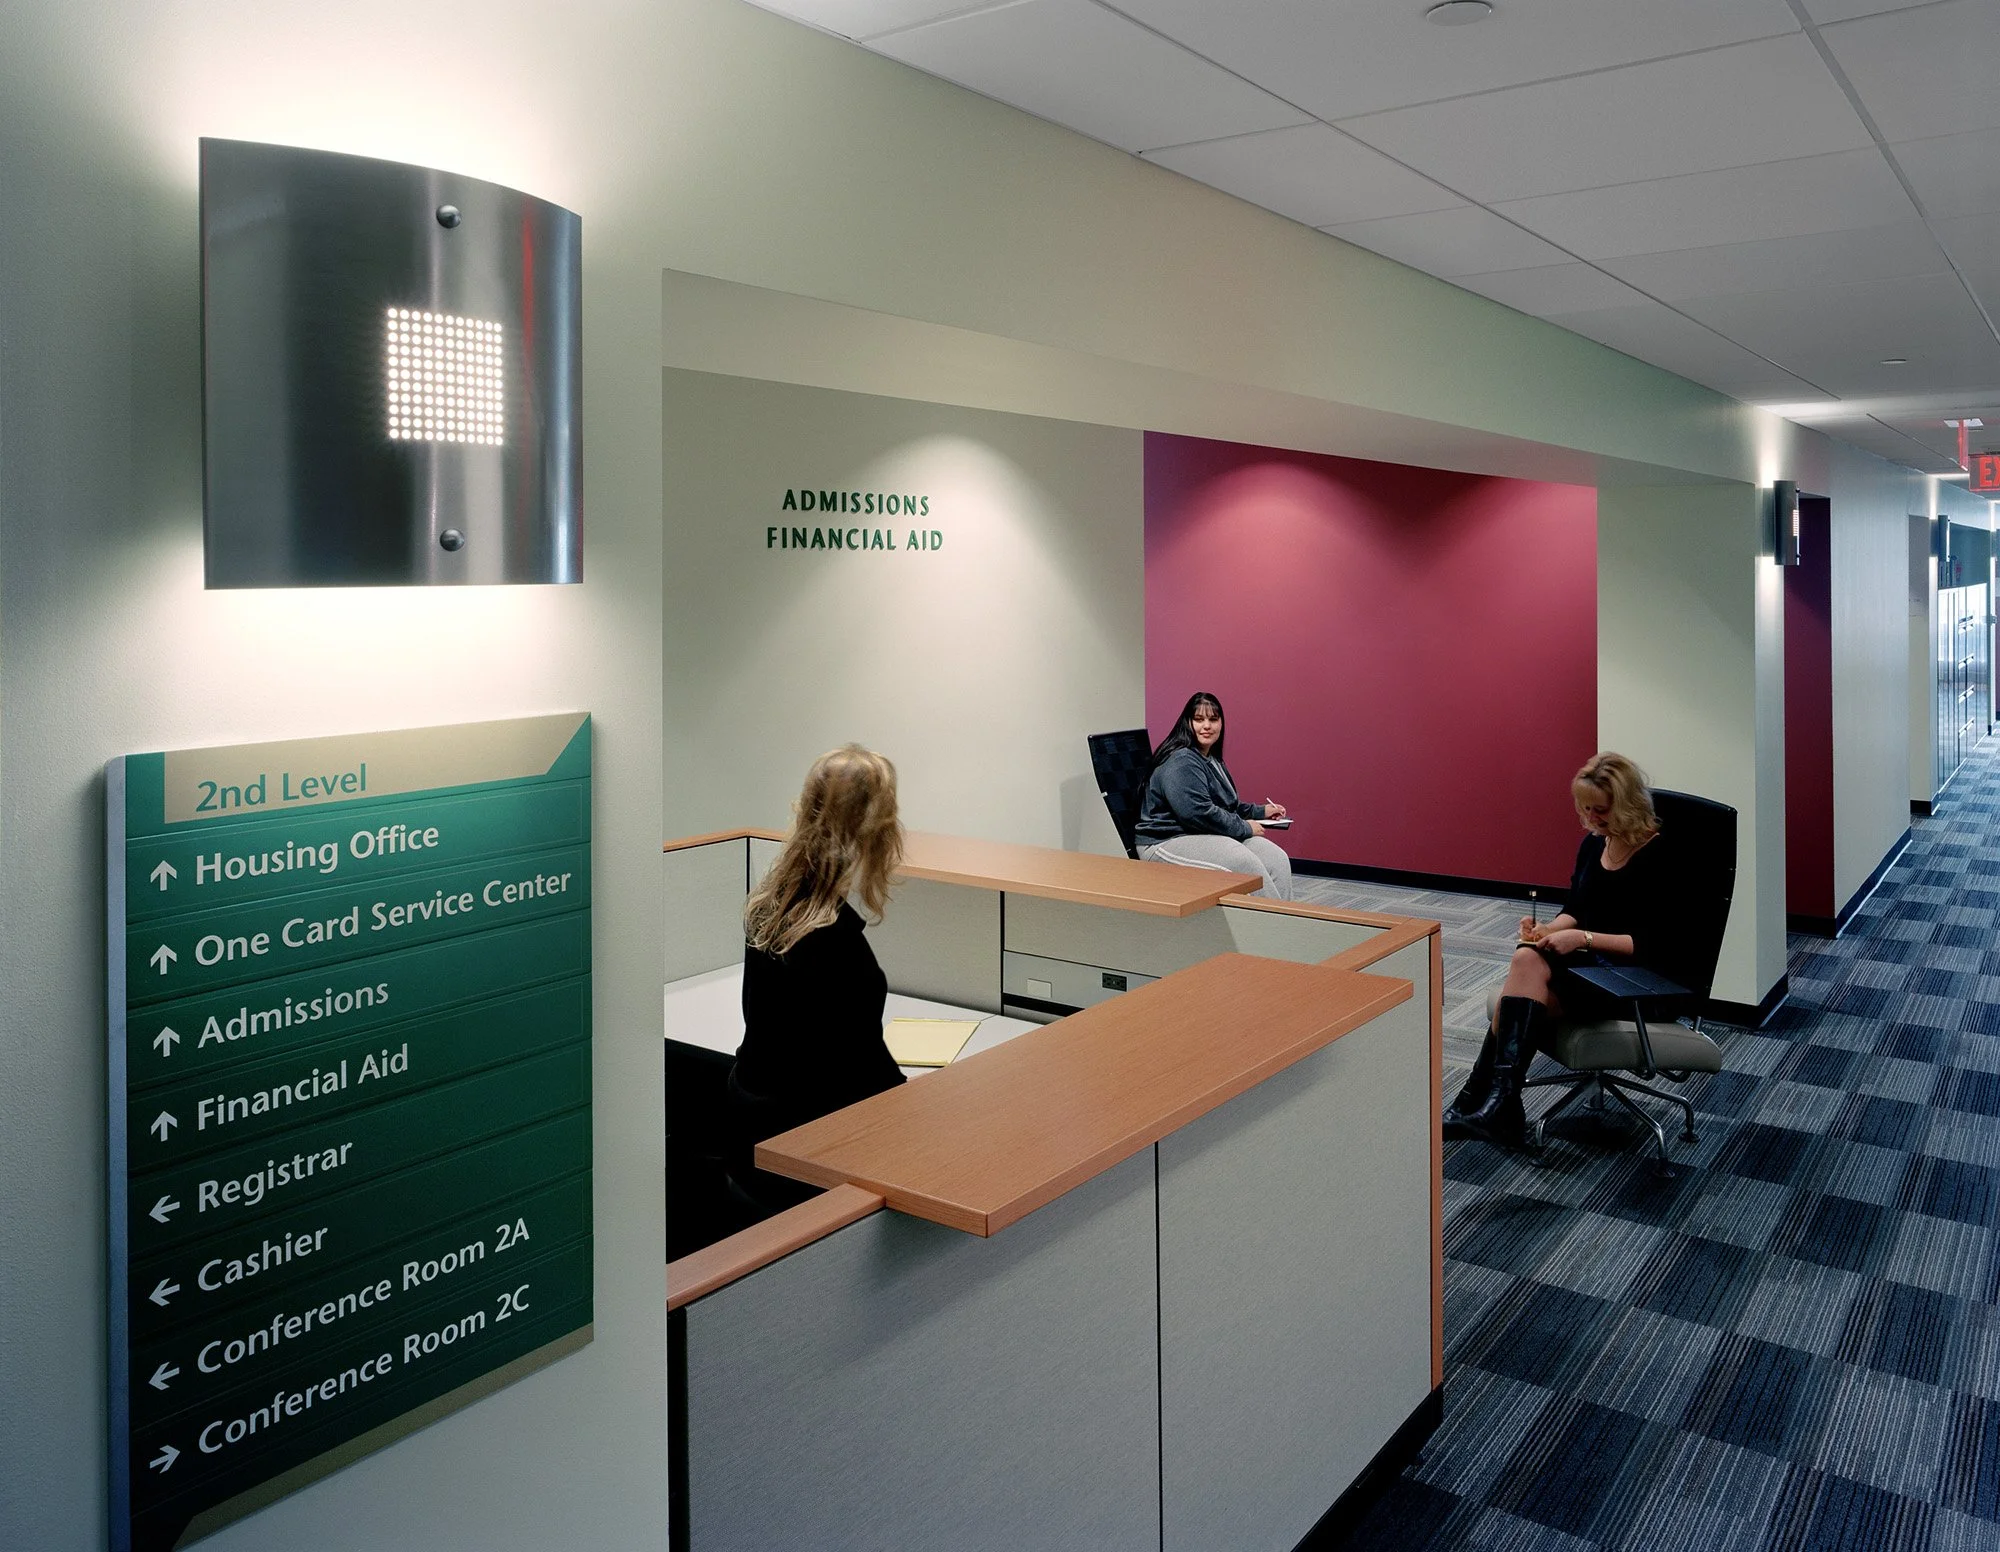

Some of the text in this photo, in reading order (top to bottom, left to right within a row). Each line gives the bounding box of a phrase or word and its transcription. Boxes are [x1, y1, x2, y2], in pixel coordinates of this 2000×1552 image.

[782, 488, 929, 516] ADMISSIONS
[767, 526, 944, 551] FINANCIAL AID
[195, 763, 367, 812] 2nd Level
[195, 824, 439, 885] Housing Office
[194, 869, 571, 966] One Card Service Center
[197, 983, 389, 1049] Admissions
[197, 1043, 409, 1131] Financial Aid
[198, 1140, 353, 1213] Registrar
[197, 1225, 328, 1291] Cashier
[197, 1217, 531, 1374] Conference Room 2A
[198, 1284, 531, 1455] Conference Room 2C
